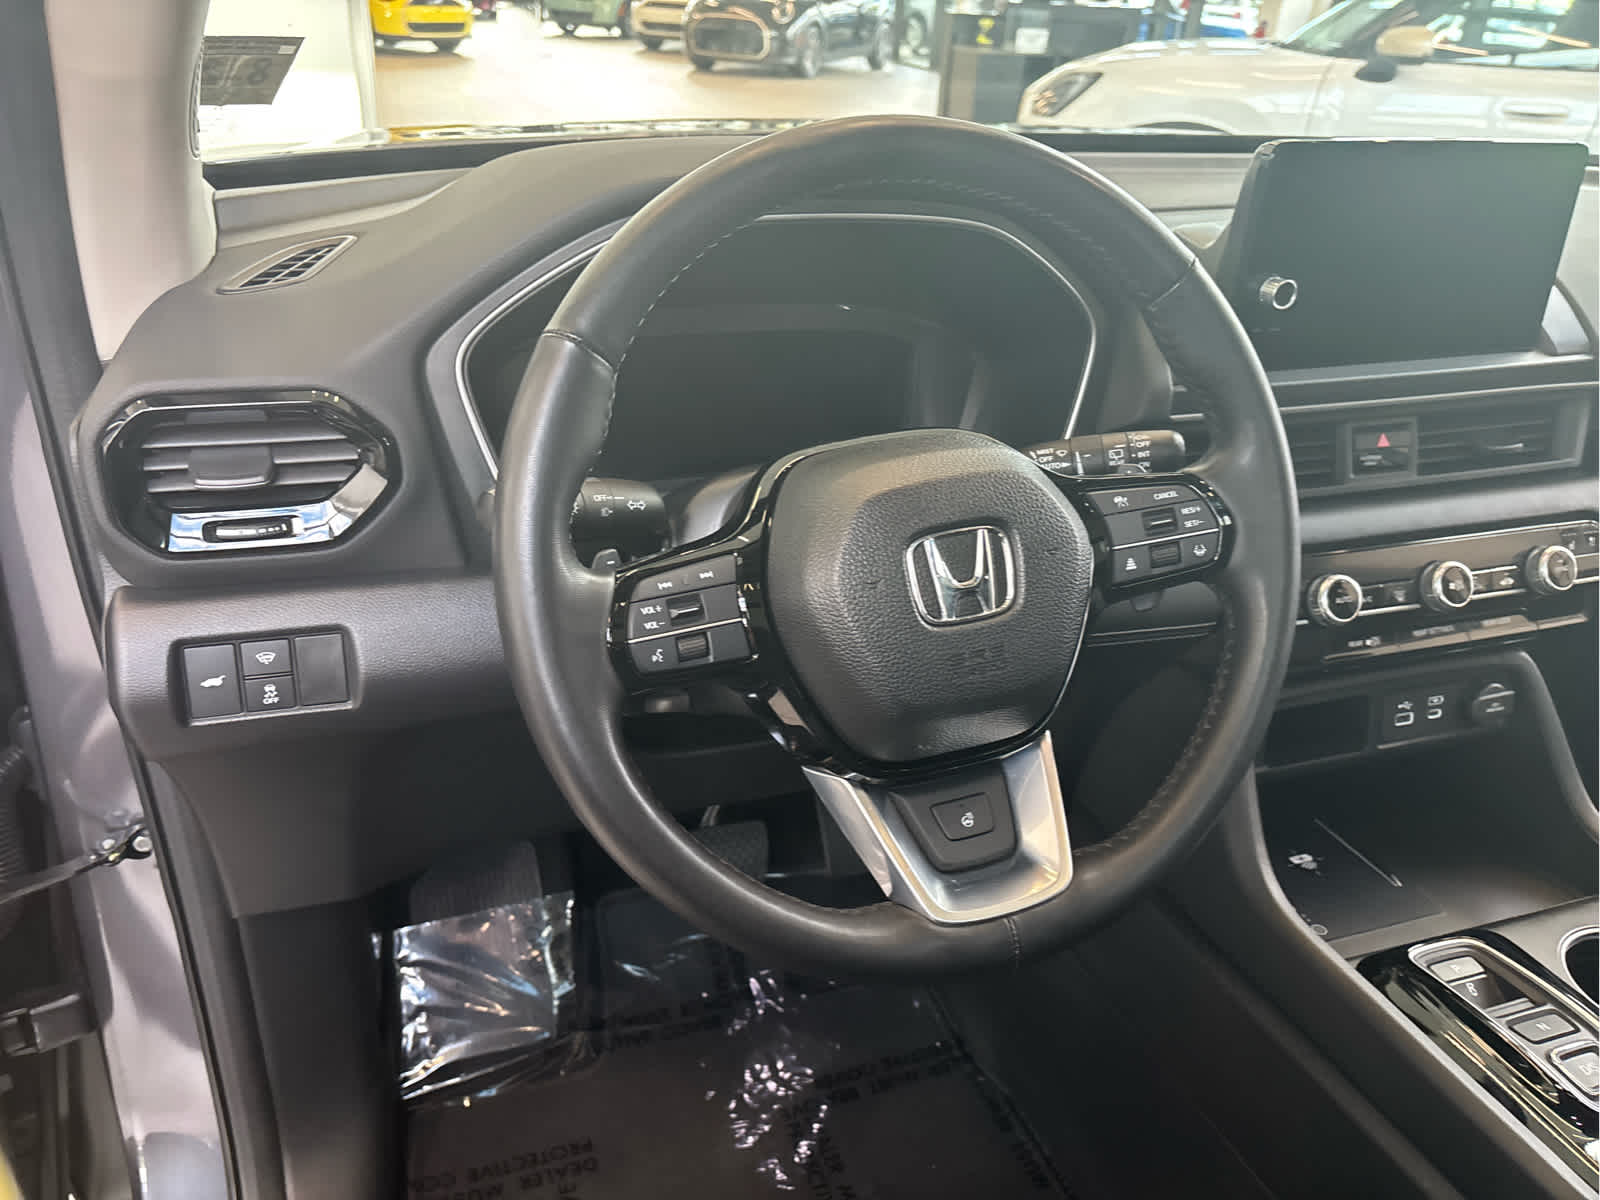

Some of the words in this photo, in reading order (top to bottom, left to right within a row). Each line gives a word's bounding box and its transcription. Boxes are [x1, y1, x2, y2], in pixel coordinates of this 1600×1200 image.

[1136, 440, 1151, 448] OFF
[1137, 450, 1150, 458] INT
[1153, 490, 1179, 500] CANCEL
[263, 696, 280, 705] OFF
